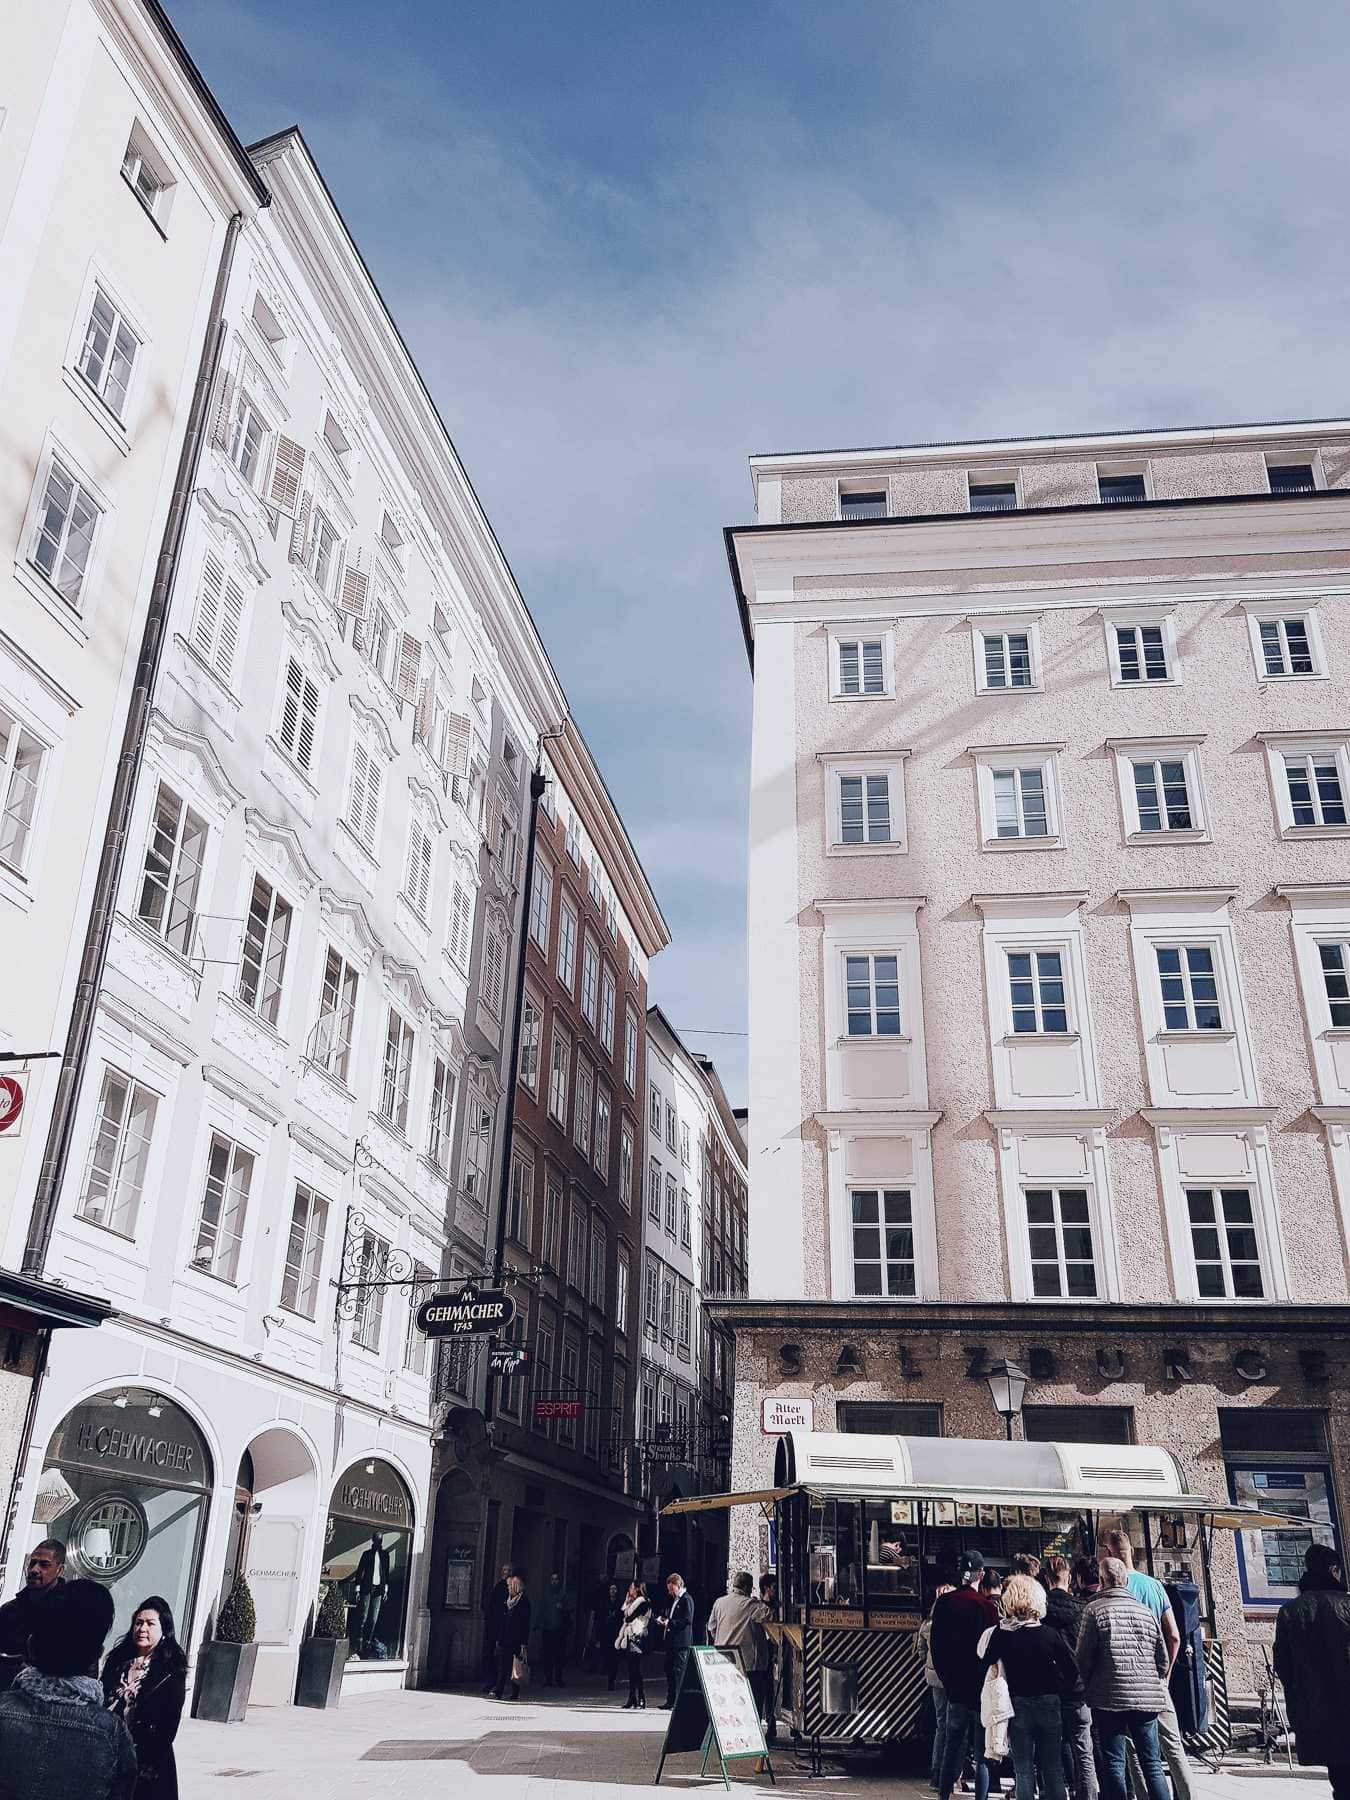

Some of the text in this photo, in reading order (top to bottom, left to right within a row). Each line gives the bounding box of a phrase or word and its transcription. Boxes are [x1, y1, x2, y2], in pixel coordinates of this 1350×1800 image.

[426, 1303, 504, 1322] GEHMACHER
[536, 1402, 581, 1415] ESPRIT
[775, 1402, 801, 1414] Alter
[769, 1414, 806, 1425] Markt
[95, 1425, 194, 1473] GEHMACHER
